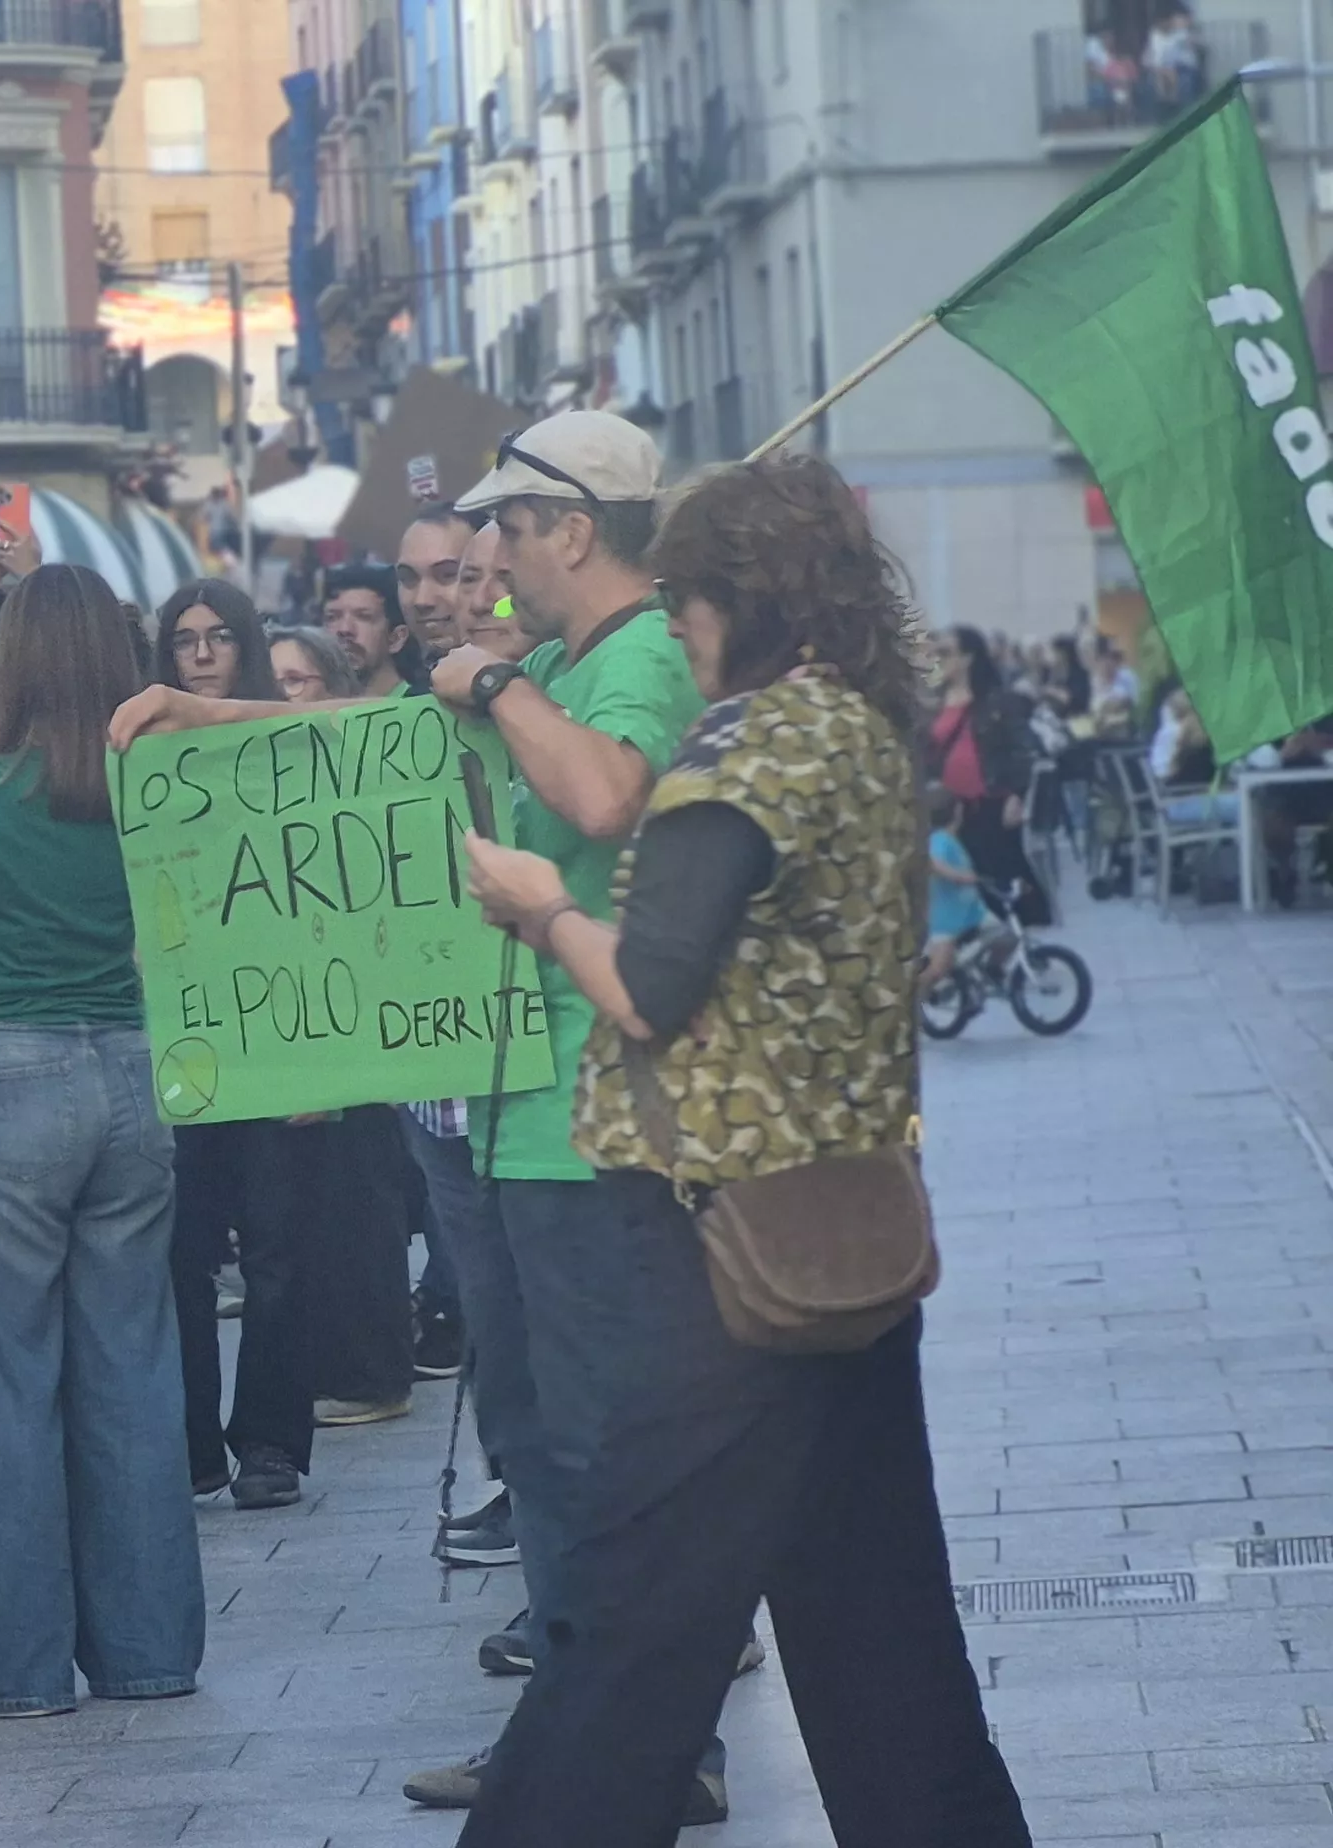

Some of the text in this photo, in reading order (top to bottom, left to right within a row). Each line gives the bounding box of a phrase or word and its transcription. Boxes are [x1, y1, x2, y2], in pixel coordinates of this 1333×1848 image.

[420, 940, 454, 965] SE
[182, 958, 549, 1054] EL POLO DERRITE
